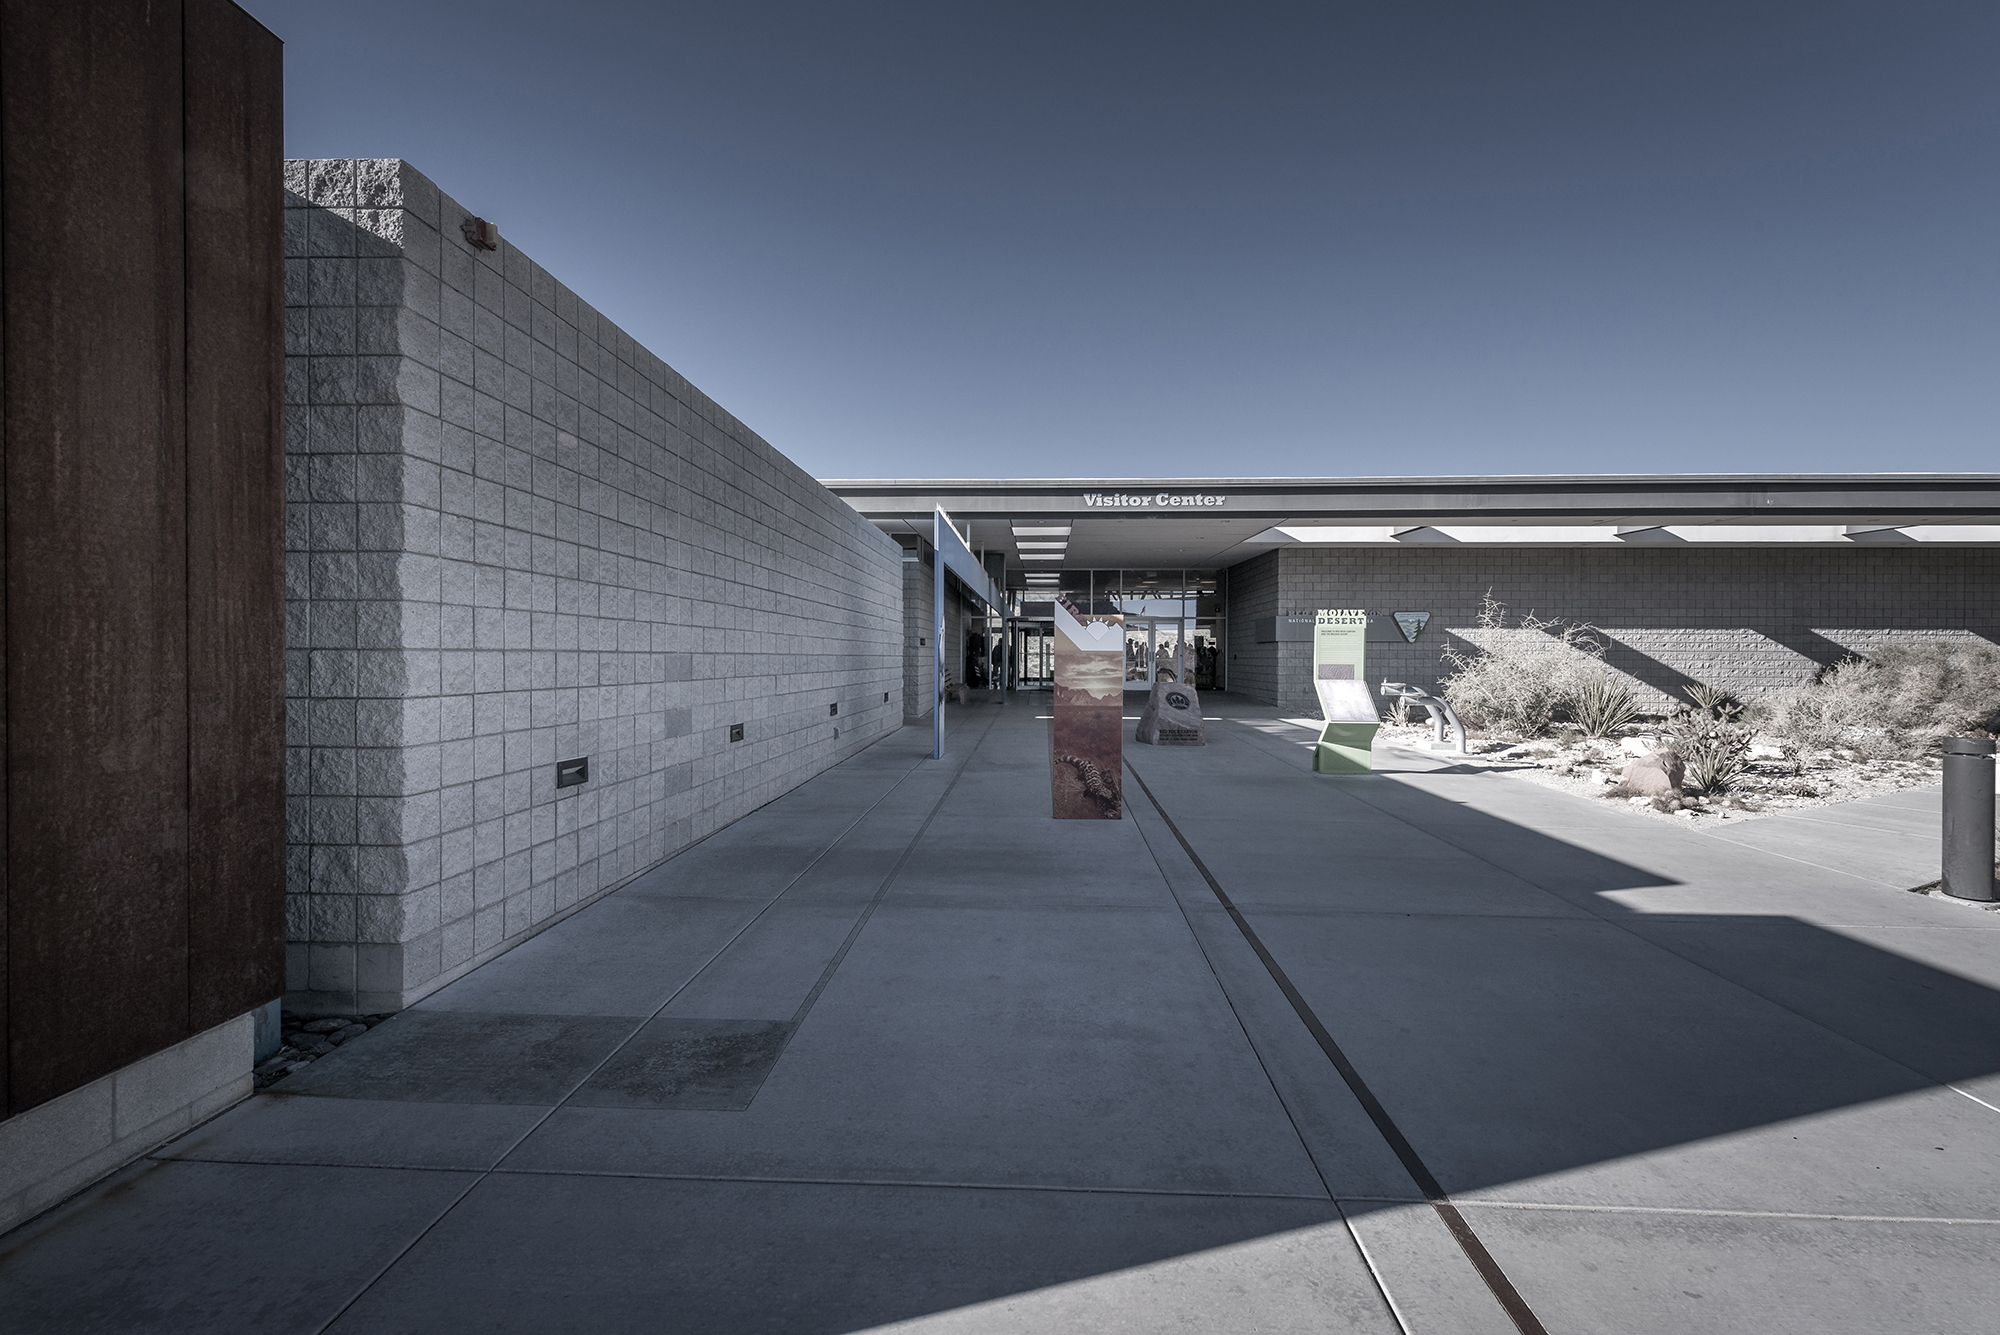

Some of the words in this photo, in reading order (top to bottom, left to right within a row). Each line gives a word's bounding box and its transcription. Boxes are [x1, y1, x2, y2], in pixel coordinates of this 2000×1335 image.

[1083, 493, 1152, 507] Visitor
[1155, 492, 1226, 507] Center
[1055, 592, 1087, 626] FIRE
[1317, 609, 1366, 617] MOJAVE
[1318, 617, 1364, 625] DESERT
